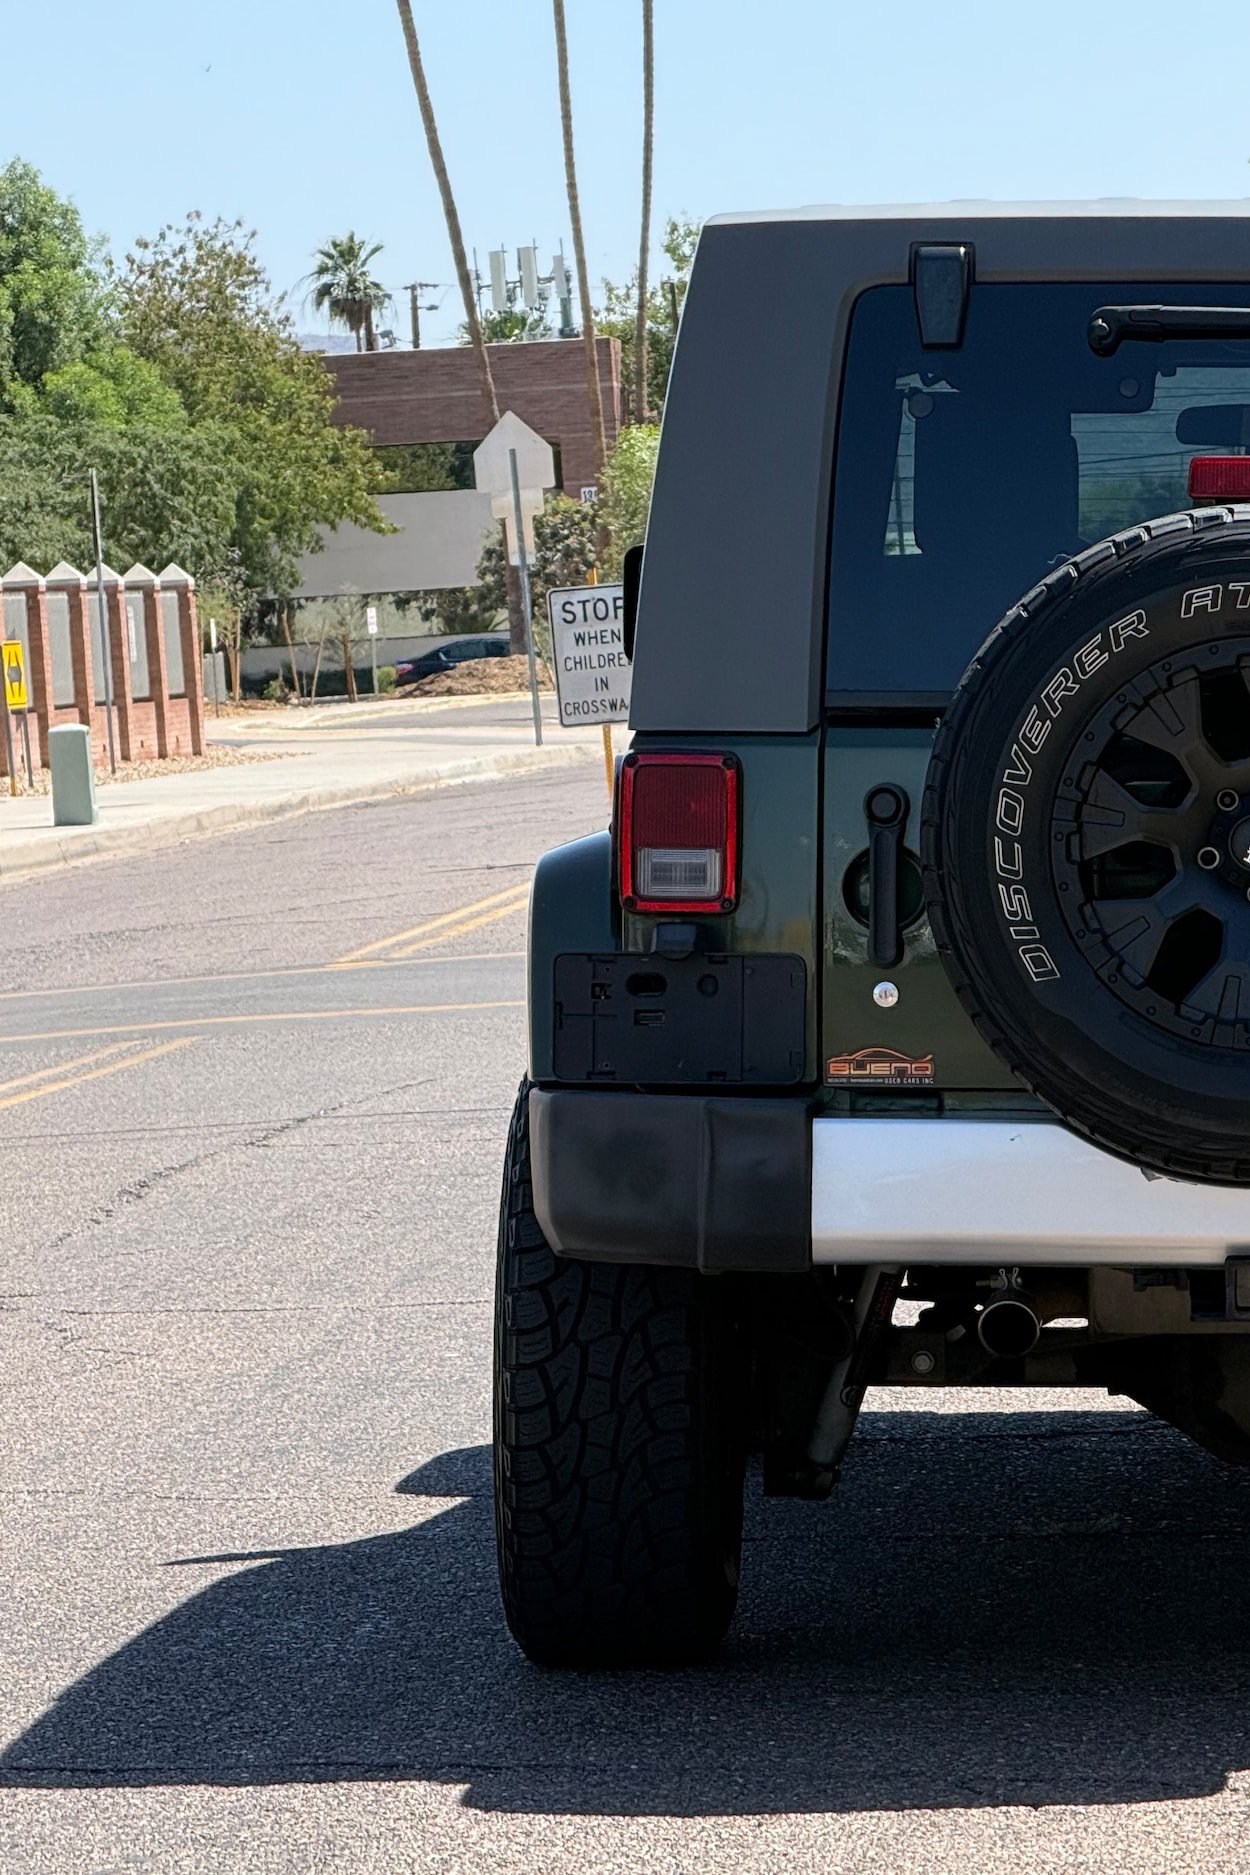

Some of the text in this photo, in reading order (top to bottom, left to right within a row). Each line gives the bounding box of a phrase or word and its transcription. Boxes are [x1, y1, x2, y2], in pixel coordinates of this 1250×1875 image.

[573, 628, 622, 647] WHEN
[564, 652, 632, 672] CHILDRE
[594, 676, 610, 692] IN
[564, 697, 629, 716] CROSSWA
[995, 609, 1149, 981] DISCOVERER
[829, 1062, 932, 1075] BUENO
